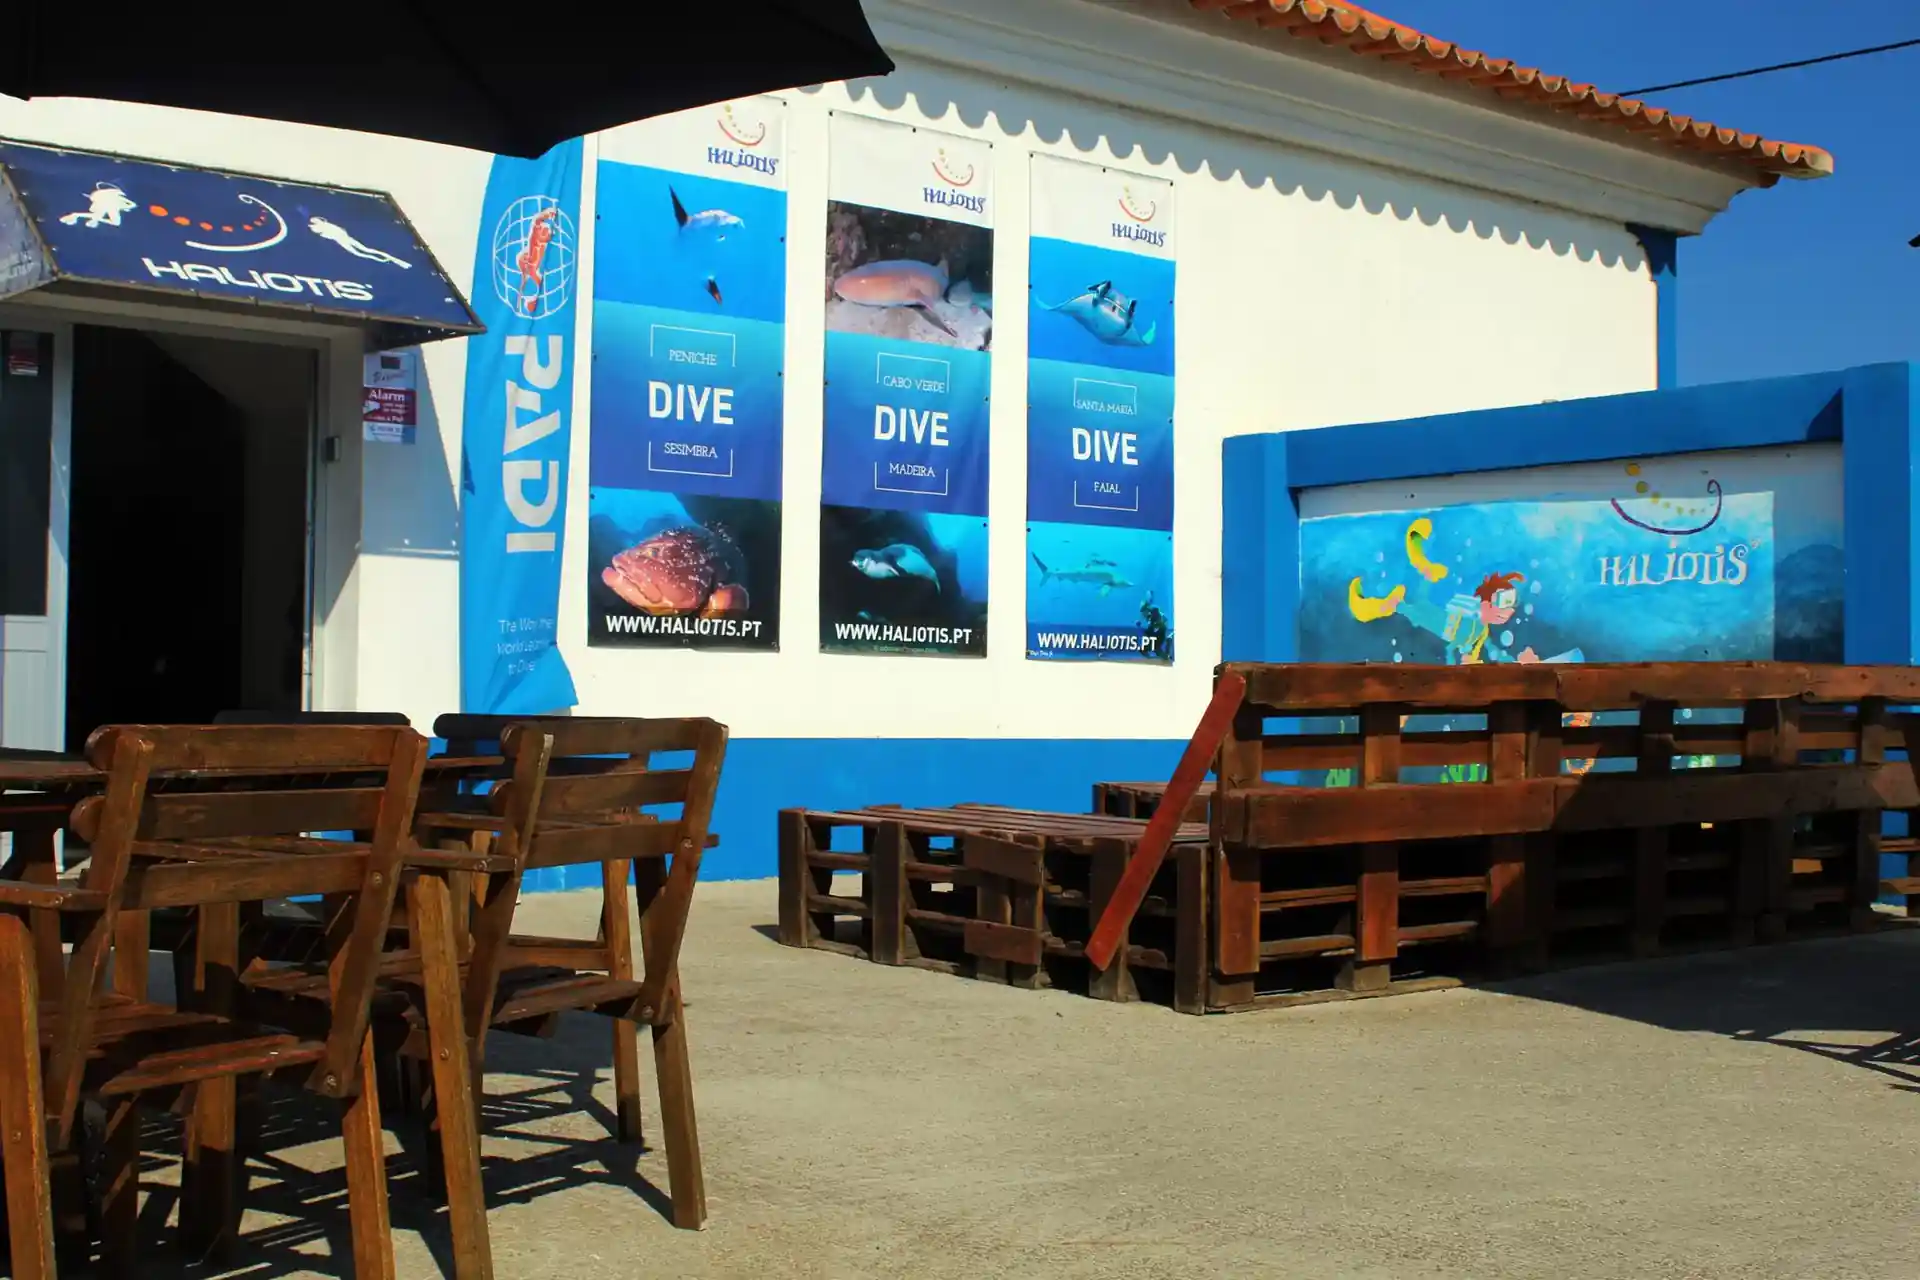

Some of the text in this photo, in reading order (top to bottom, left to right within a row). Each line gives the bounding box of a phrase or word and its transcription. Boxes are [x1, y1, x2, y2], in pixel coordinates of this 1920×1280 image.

[141, 257, 374, 301] HALIOTIS
[669, 349, 717, 366] PENICHE
[883, 375, 945, 393] CABO VERDE
[648, 380, 734, 425] DIVE
[1076, 400, 1134, 415] SANTA MARIA
[874, 404, 949, 446] DIVE
[503, 335, 564, 553] PADI
[664, 442, 718, 458] SESIMBRA
[1072, 427, 1139, 466] DIVE
[889, 462, 936, 477] MADEIRA
[1094, 481, 1120, 494] FAIAL
[606, 615, 762, 637] WWW.HALIOTIS.PT
[835, 623, 972, 644] WWW.HALIOTIS.PT
[1037, 632, 1157, 651] WWW.HALIOTIS.PT
